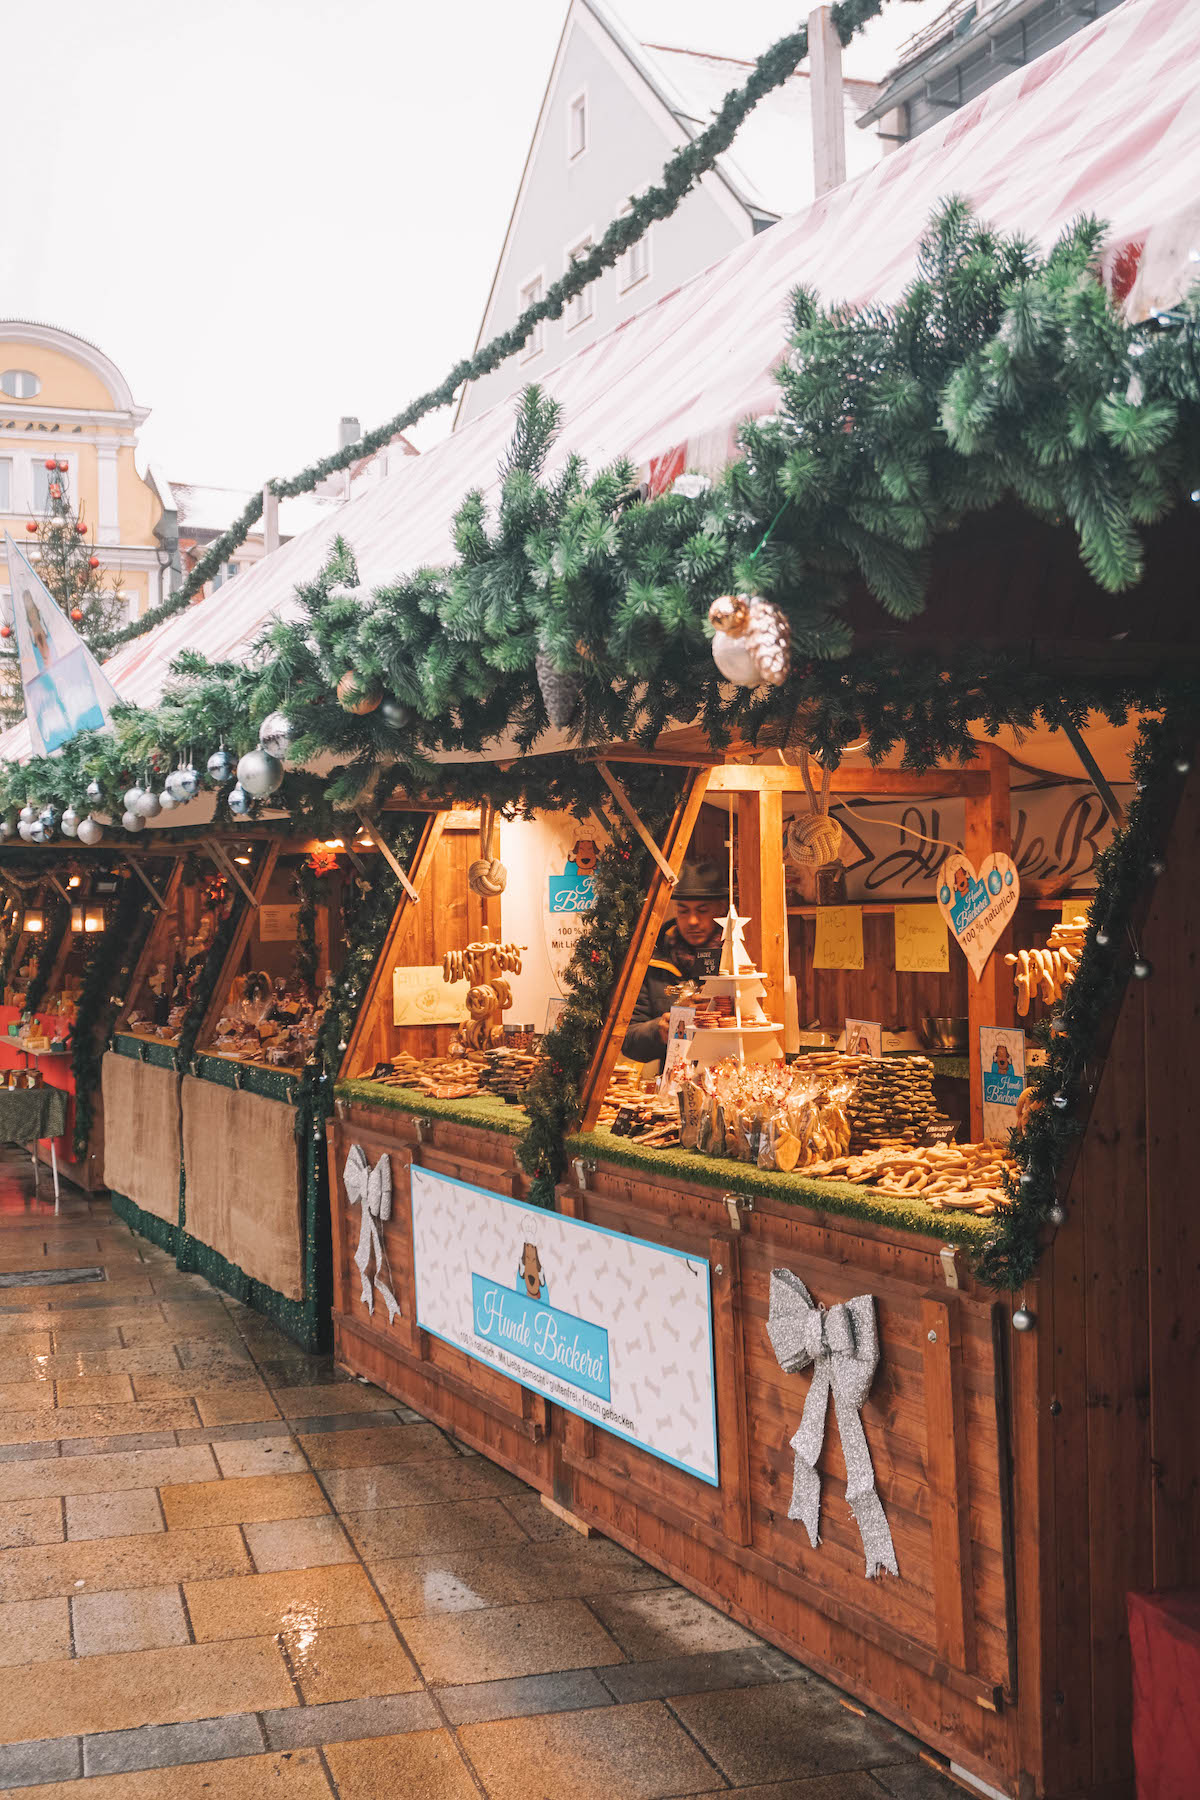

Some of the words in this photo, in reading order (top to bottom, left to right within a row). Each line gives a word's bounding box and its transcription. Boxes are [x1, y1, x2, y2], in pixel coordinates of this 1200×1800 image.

[553, 889, 597, 912] Bäck
[963, 884, 985, 911] Hunde
[956, 896, 989, 932] Bäckerei
[963, 928, 976, 946] 100
[976, 920, 984, 933] %
[984, 890, 1016, 926] natürlich
[551, 940, 564, 949] Mit
[565, 940, 577, 949] Lie
[557, 927, 573, 936] 100
[997, 1076, 1022, 1091] Hunde
[476, 1289, 531, 1348] Hunde
[533, 1311, 606, 1383] Bäckerei
[498, 1351, 506, 1366] Mit
[506, 1355, 521, 1373] Liebe
[521, 1365, 545, 1386] gemacht
[549, 1380, 578, 1402] glutenfrei
[582, 1394, 601, 1414] frisch
[601, 1405, 635, 1431] gebacken
